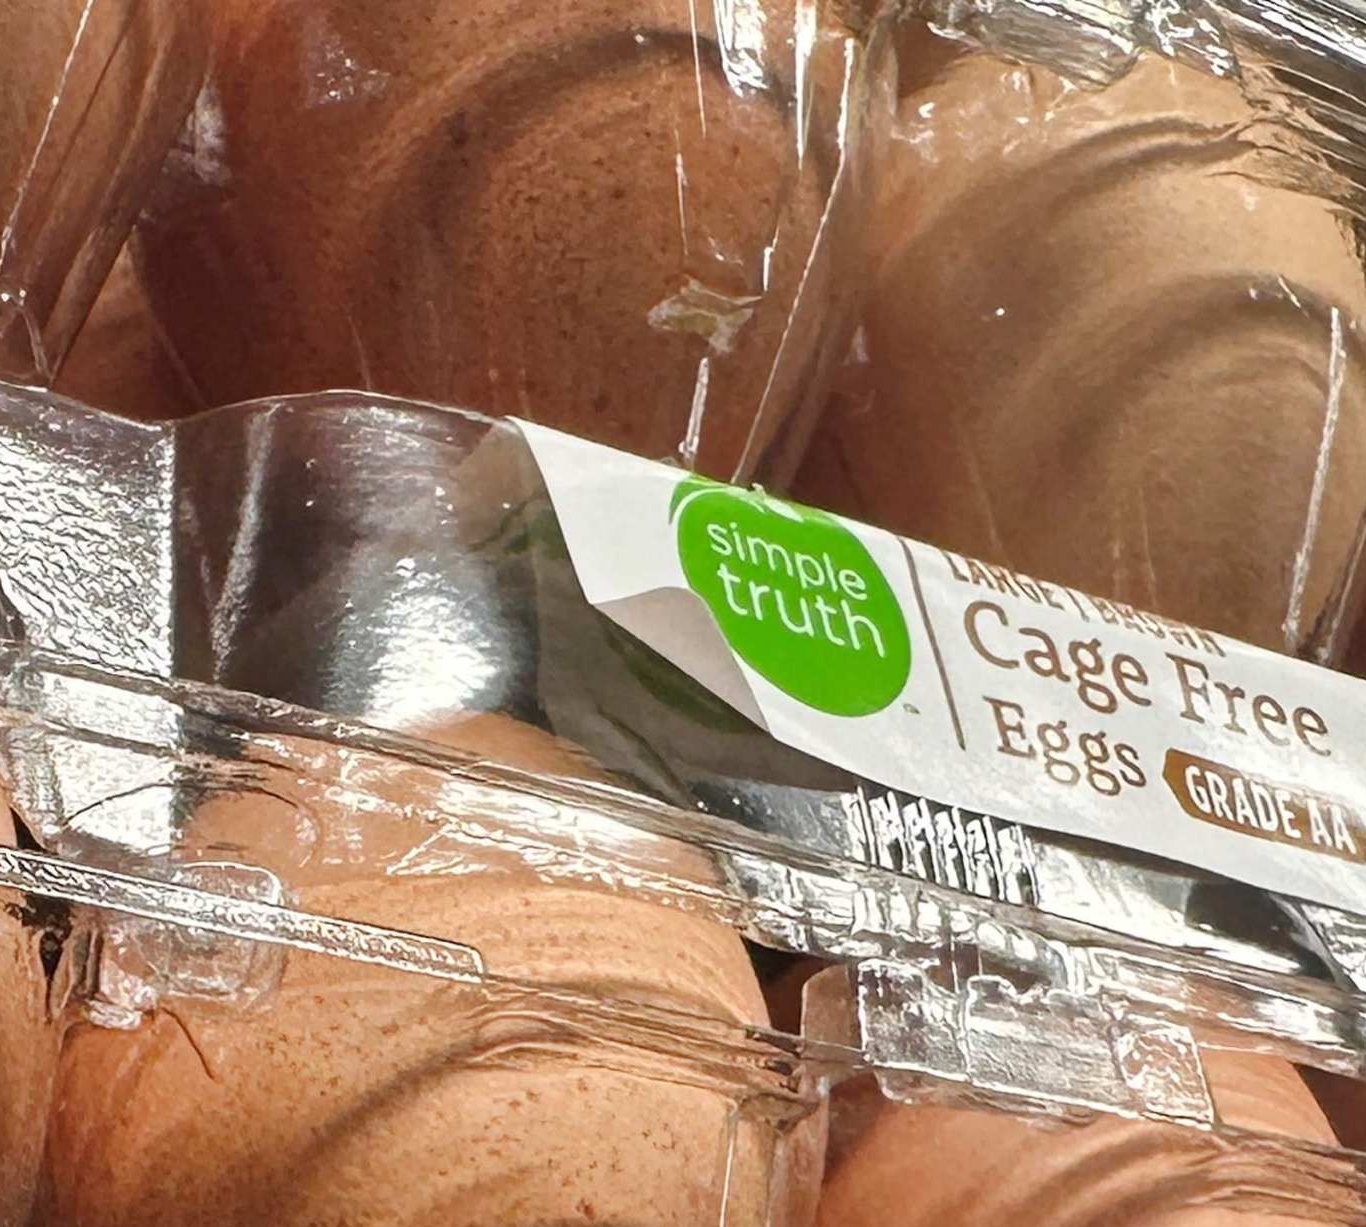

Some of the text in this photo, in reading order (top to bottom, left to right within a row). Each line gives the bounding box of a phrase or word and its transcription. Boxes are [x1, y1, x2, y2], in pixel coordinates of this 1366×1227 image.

[706, 521, 868, 601] simple
[717, 562, 885, 659] truth
[964, 600, 1332, 758] Cage Free
[983, 694, 1357, 857] Eggs GRADE AA
